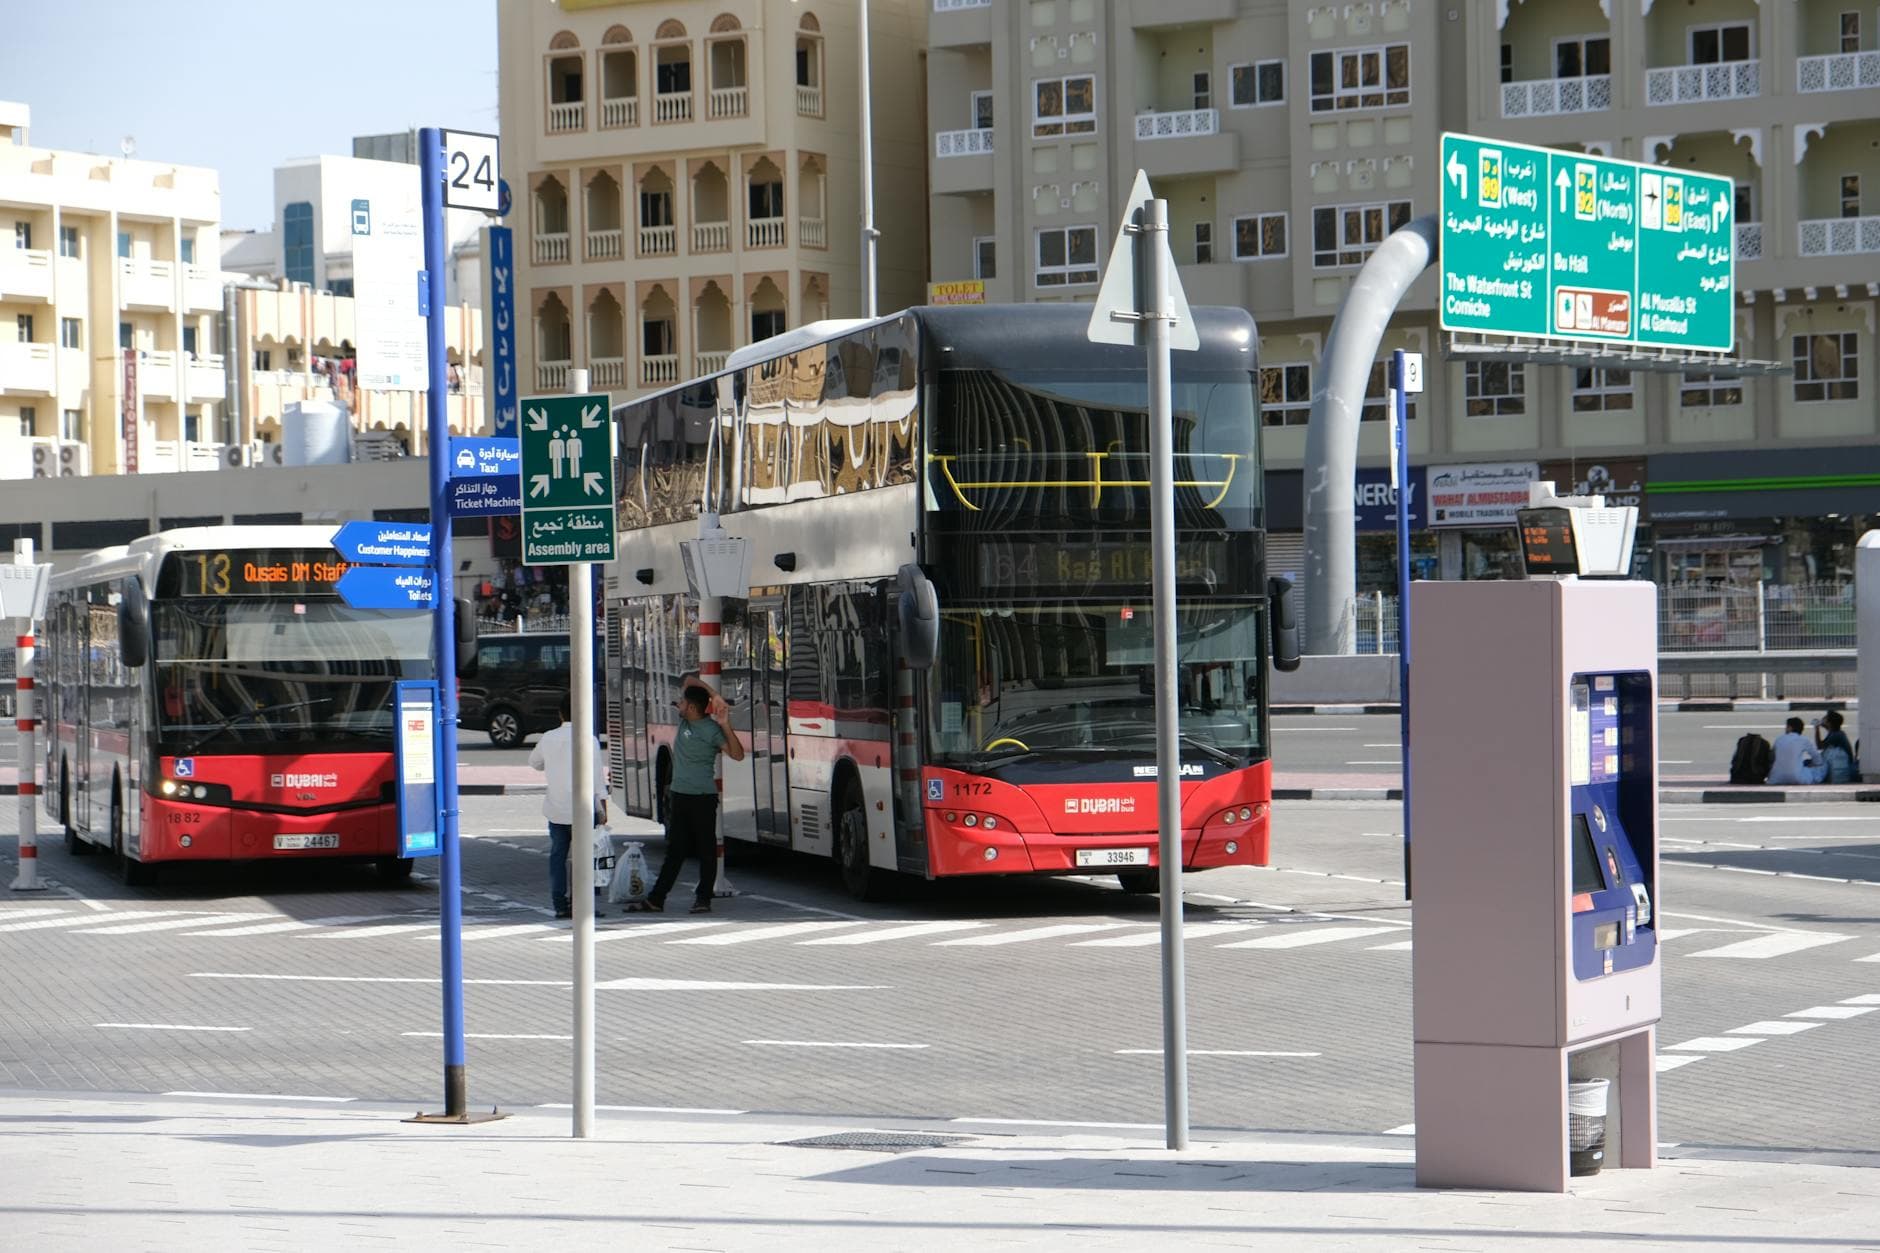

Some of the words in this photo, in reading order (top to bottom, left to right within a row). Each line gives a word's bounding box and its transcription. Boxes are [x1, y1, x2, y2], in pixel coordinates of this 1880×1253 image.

[450, 150, 494, 192] 24
[1503, 186, 1537, 212] (West)
[1597, 199, 1633, 225] (North)
[1447, 212, 1482, 234] البحرية
[1484, 216, 1519, 239] الواجهة
[1684, 211, 1711, 234] (East)
[1520, 222, 1545, 243] شارع
[1554, 252, 1568, 271] Bu
[1569, 254, 1588, 274] Hail
[1708, 246, 1730, 265] شارع
[1446, 271, 1465, 292] The
[1467, 274, 1519, 298] Waterfront
[1520, 280, 1533, 299] St
[1446, 295, 1491, 317] Corniche
[1640, 292, 1651, 310] Al
[1686, 296, 1697, 314] St
[1640, 313, 1651, 331] Al
[1652, 313, 1688, 335] Garhoud
[1409, 362, 1417, 382] 9
[479, 447, 496, 459] أجرة
[497, 448, 519, 462] سيارة
[480, 463, 499, 473] Taxi
[455, 483, 481, 496] التذاكر
[481, 483, 498, 496] جهاز
[1355, 483, 1416, 506] NERGY
[455, 498, 483, 509] Ticket
[484, 498, 521, 509] Machine
[1432, 493, 1464, 507] WAHAT
[1467, 490, 1530, 506] ALMUSTAQBA
[567, 513, 604, 531] منطقة
[1449, 510, 1474, 518] MOBILE
[1476, 509, 1505, 518] TRADING
[532, 518, 564, 539] تجمع
[411, 531, 431, 545] إسعاد
[357, 544, 393, 556] Customer
[394, 545, 431, 558] Happiness
[528, 541, 582, 557] Assembly
[585, 543, 610, 555] area
[197, 553, 231, 594] 13
[244, 562, 288, 582] Qusais
[291, 563, 310, 582] DM
[408, 590, 432, 601] Toilets
[286, 773, 323, 789] DUBAI
[953, 783, 992, 796] 1172
[1081, 797, 1120, 814] DUBAI
[168, 812, 201, 824] 1882
[304, 835, 337, 848] 24467
[1083, 857, 1090, 865] X
[1107, 851, 1135, 863] 33946
